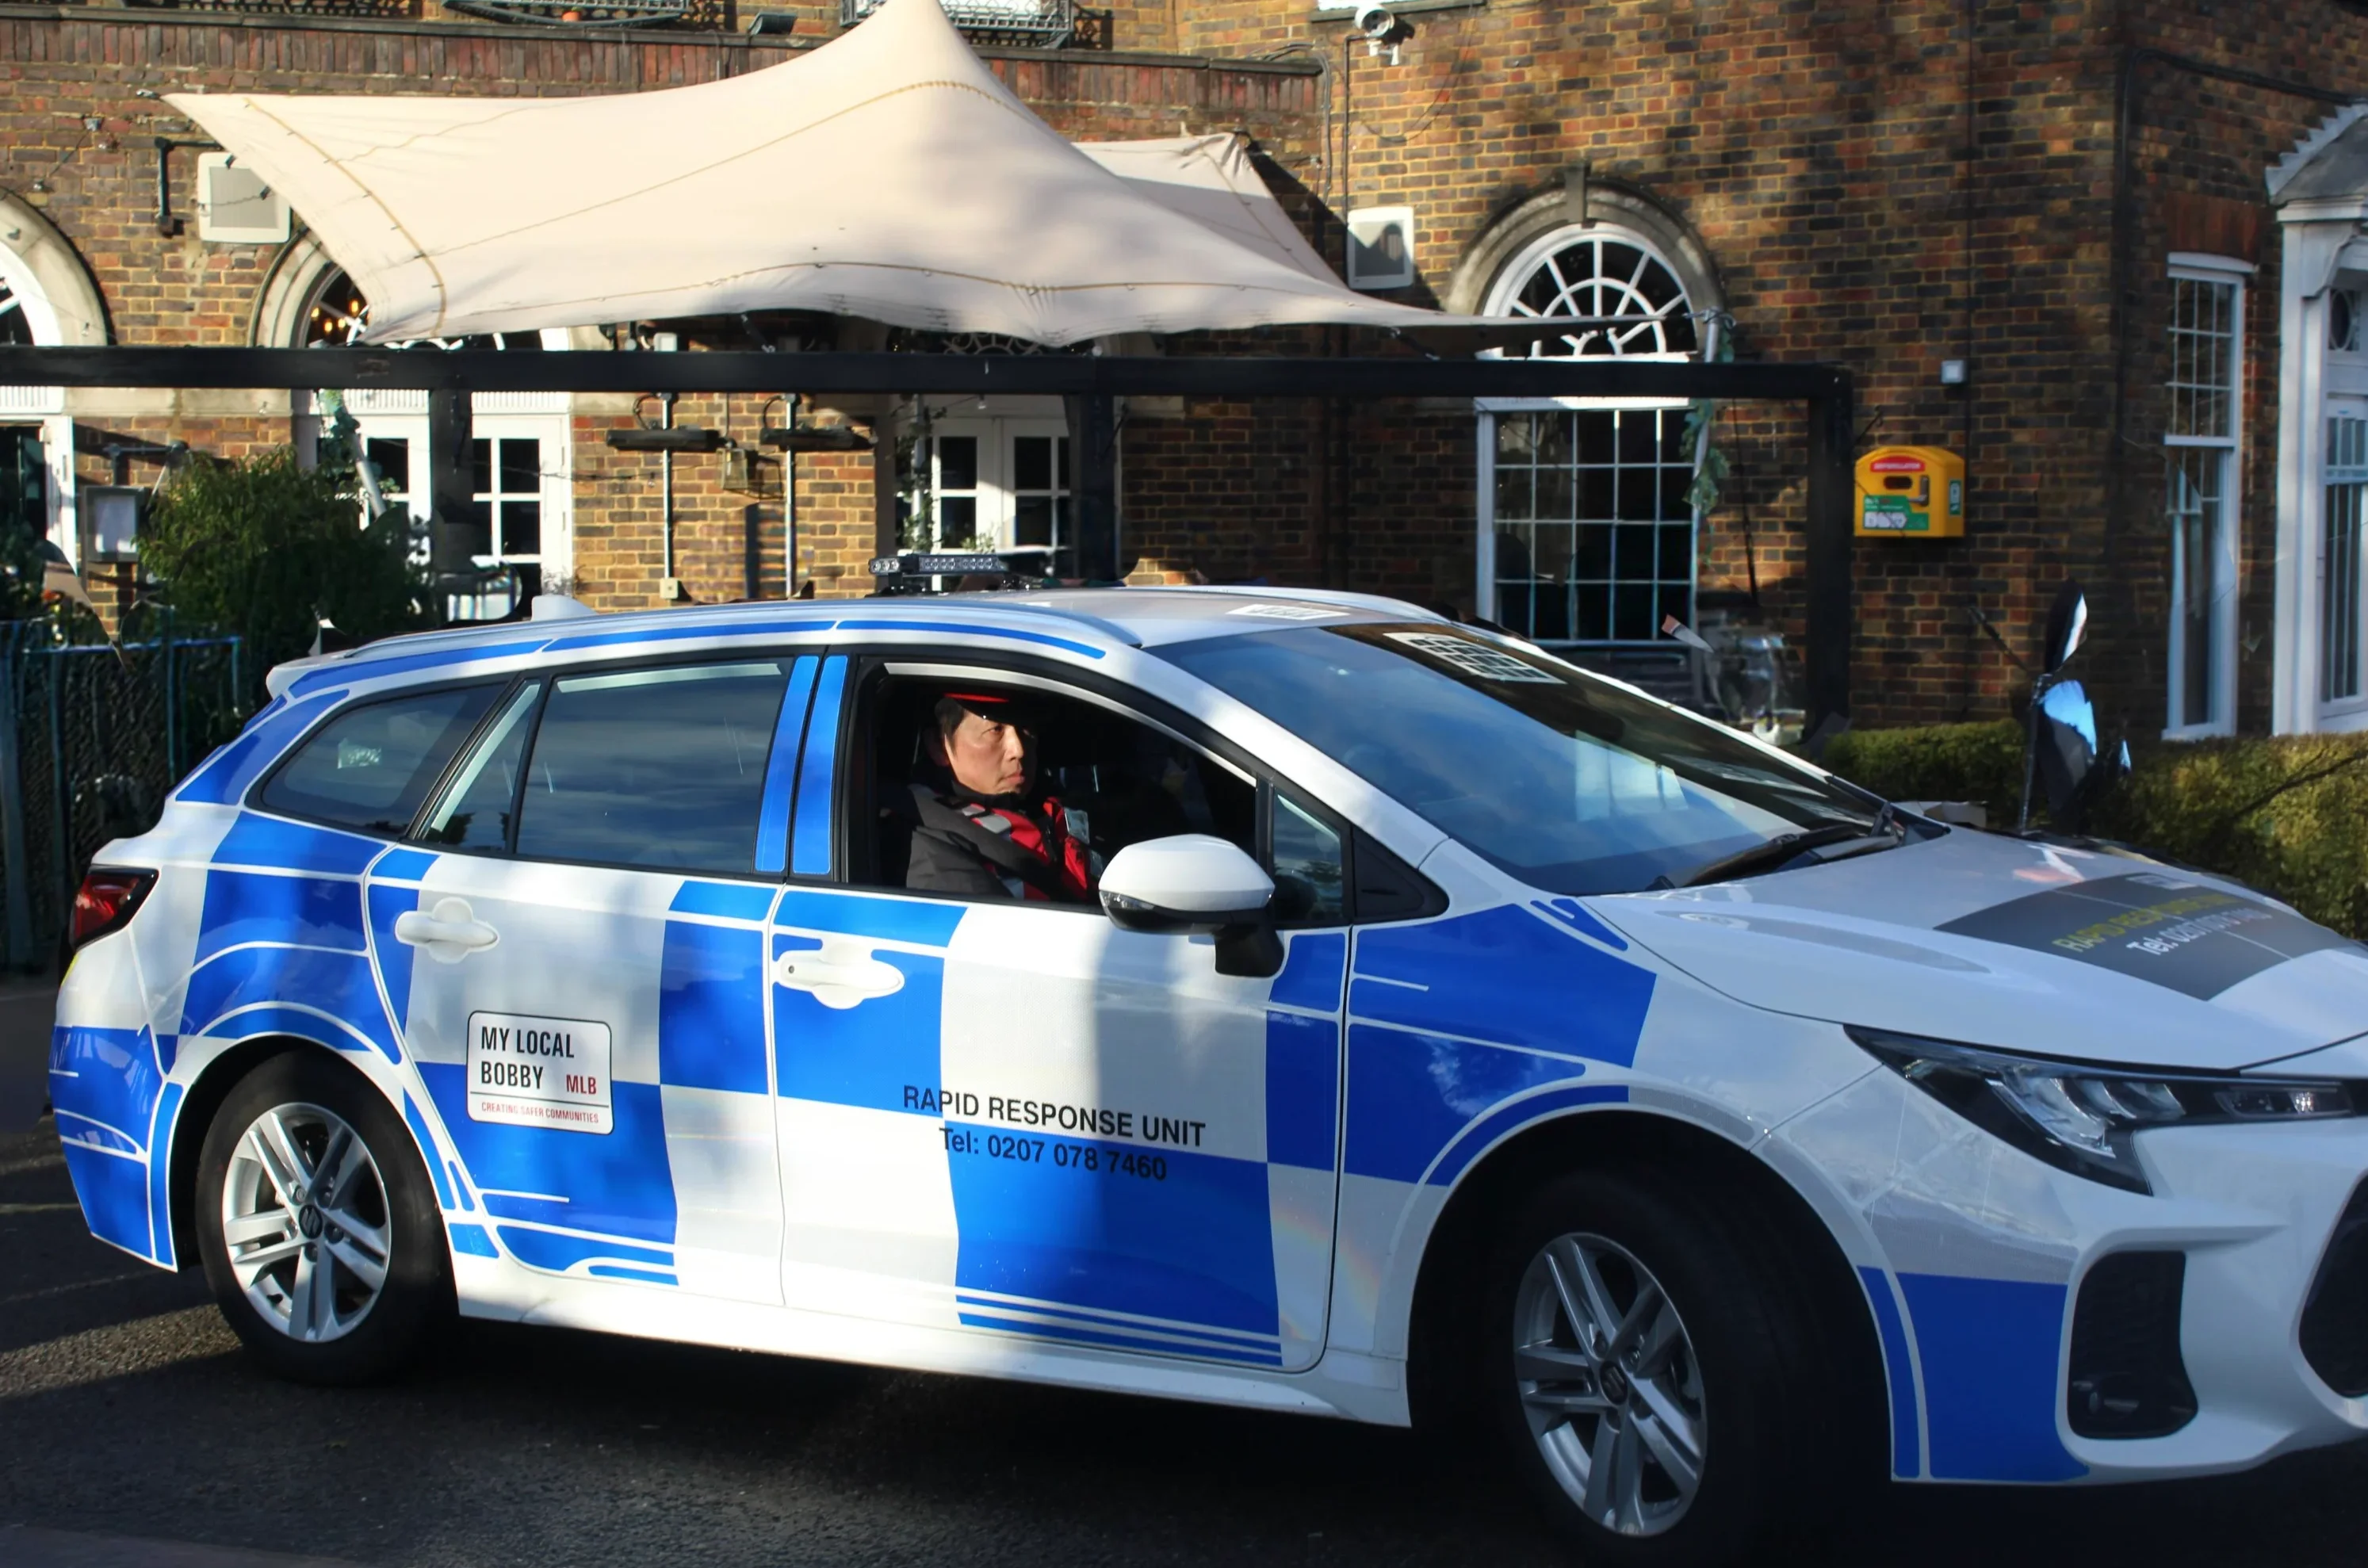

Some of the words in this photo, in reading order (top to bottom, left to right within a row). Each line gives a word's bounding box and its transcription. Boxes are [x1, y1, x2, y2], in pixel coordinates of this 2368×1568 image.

[480, 1026, 510, 1052] MY
[516, 1029, 575, 1058] LOCAL
[480, 1061, 544, 1090] BOBBY
[565, 1074, 597, 1096] MLB
[481, 1101, 519, 1115] CREATING
[520, 1105, 544, 1118] SAFER
[545, 1108, 599, 1124] COMMUNITIES
[903, 1084, 979, 1116] RAPID
[989, 1096, 1133, 1138] RESPONSE
[1142, 1115, 1206, 1147] UNIT
[939, 1127, 979, 1155] Tel:
[987, 1134, 1046, 1163] 0207
[1053, 1142, 1099, 1172] 078
[1105, 1151, 1167, 1181] 7460
